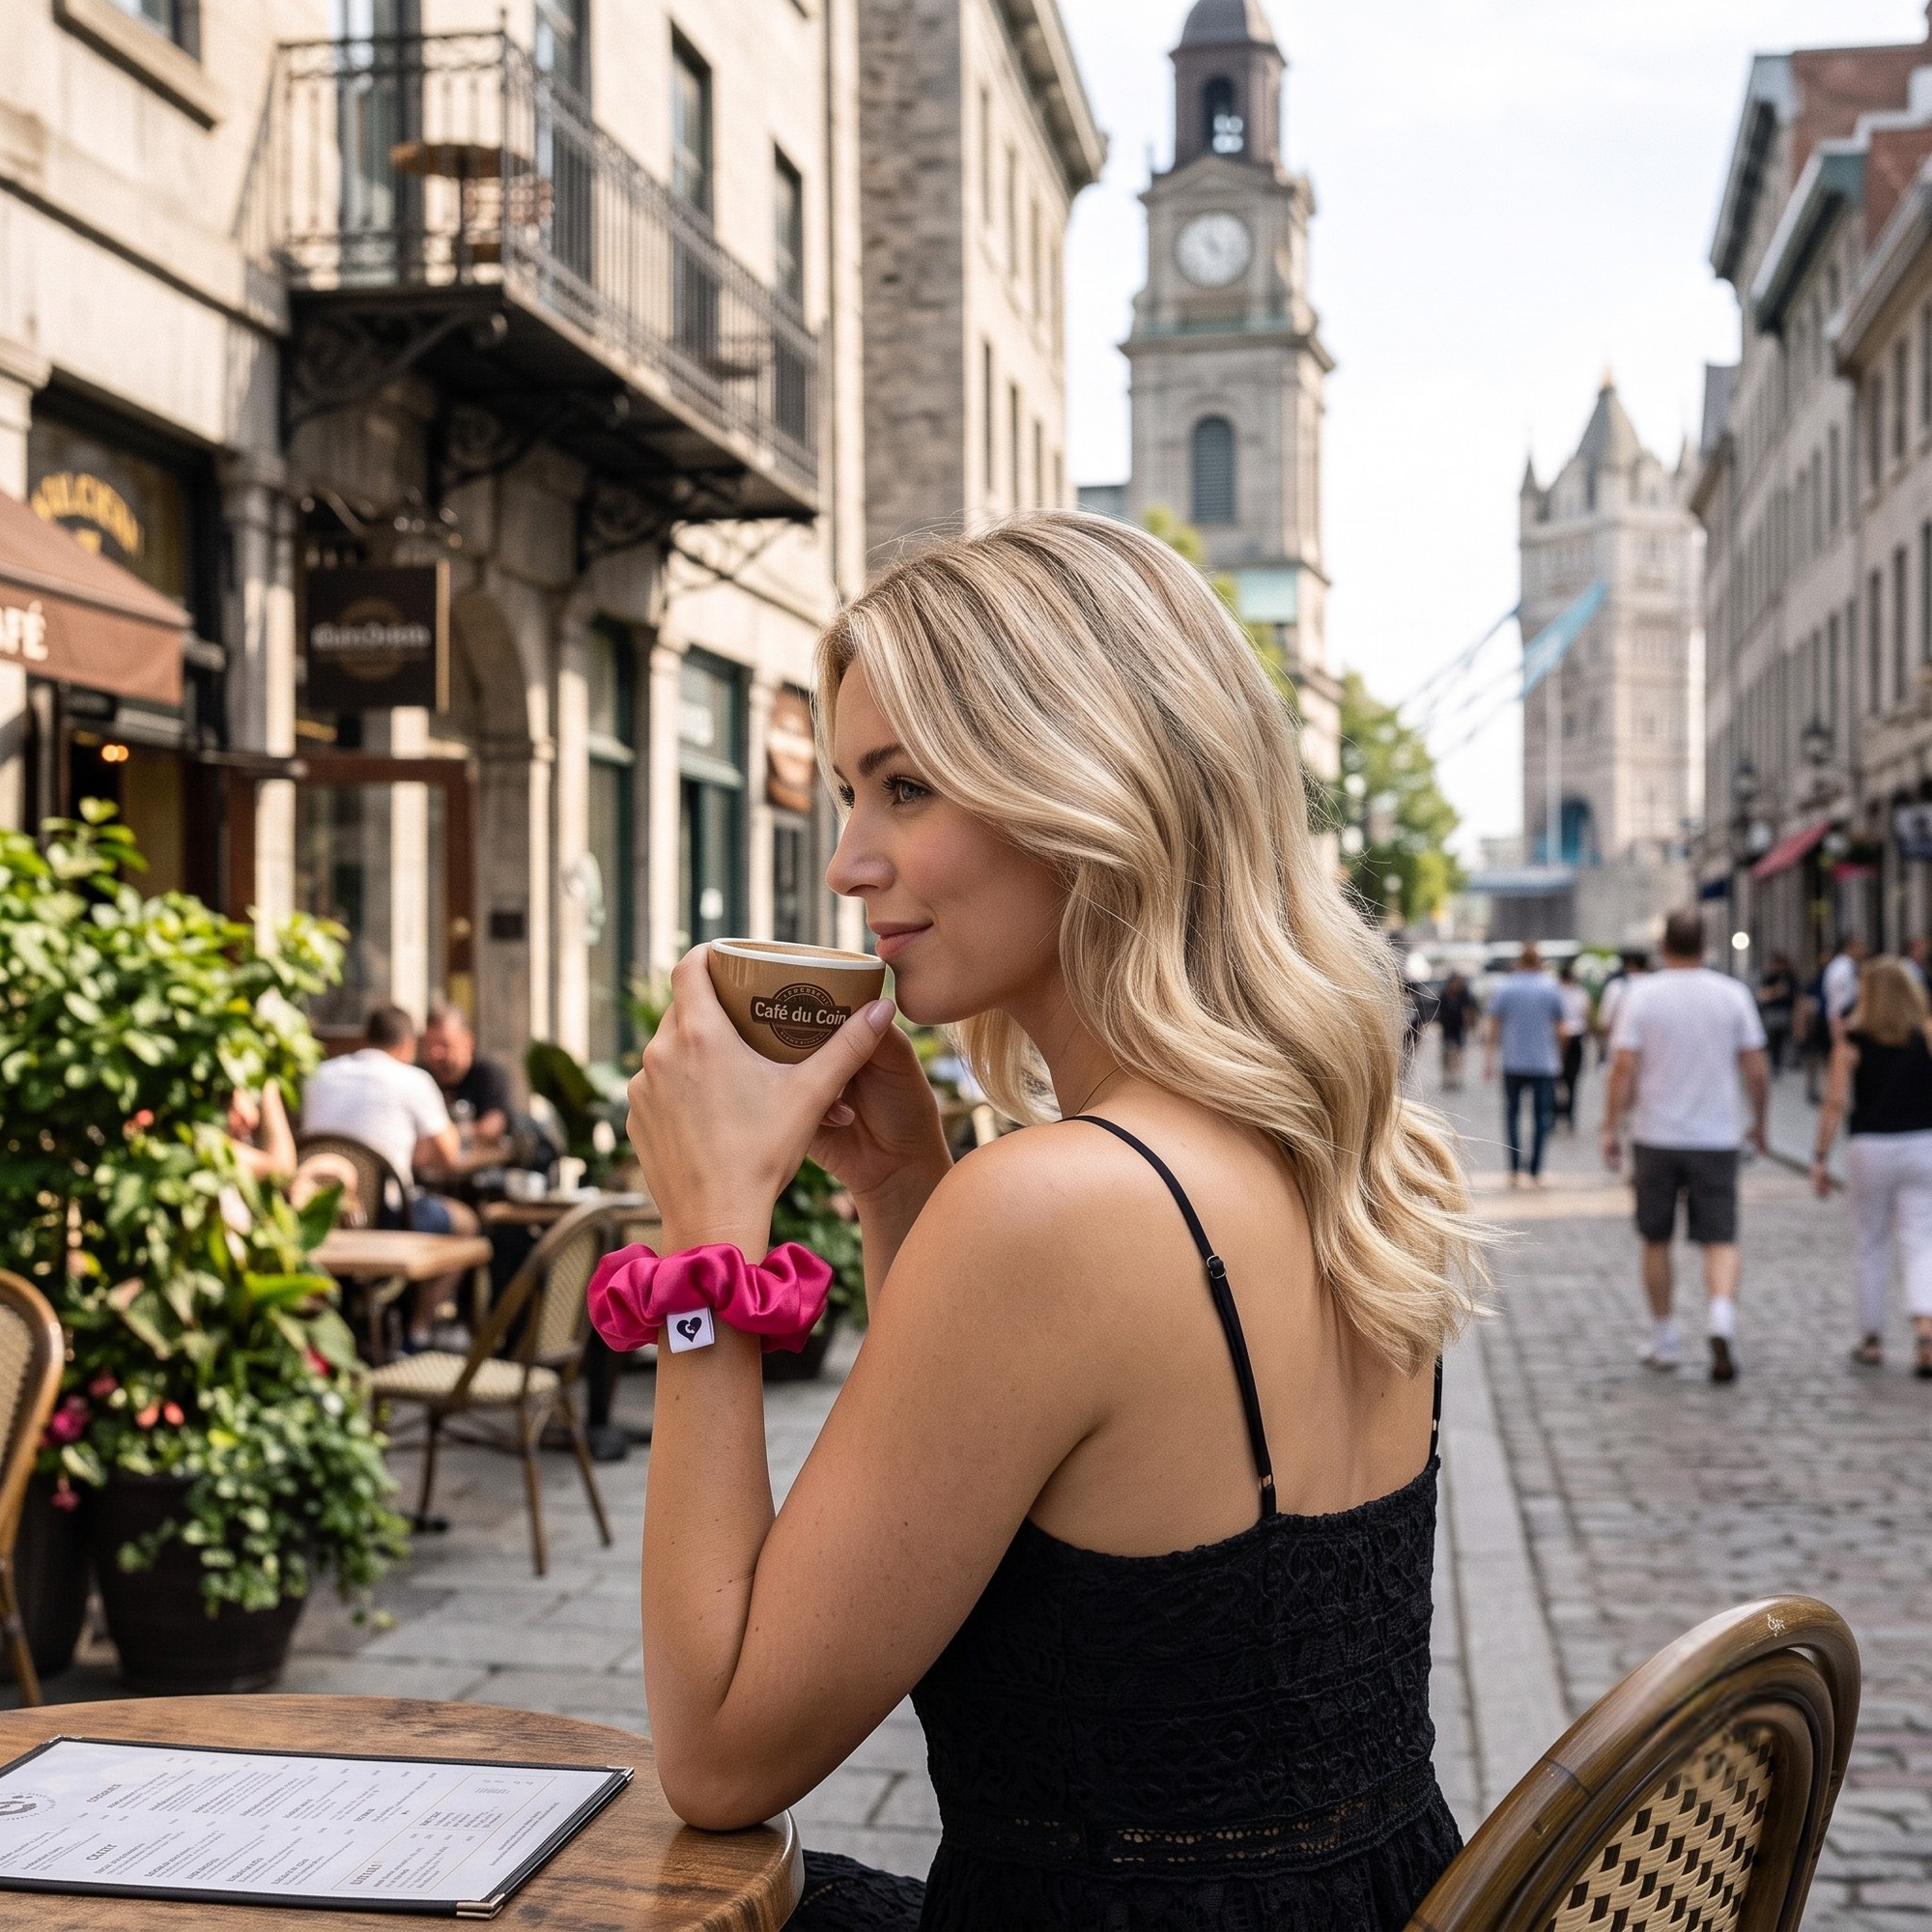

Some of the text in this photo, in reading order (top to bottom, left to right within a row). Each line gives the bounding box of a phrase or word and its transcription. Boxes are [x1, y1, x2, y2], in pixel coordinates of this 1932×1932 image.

[754, 1001, 846, 1025] Café du Coin
